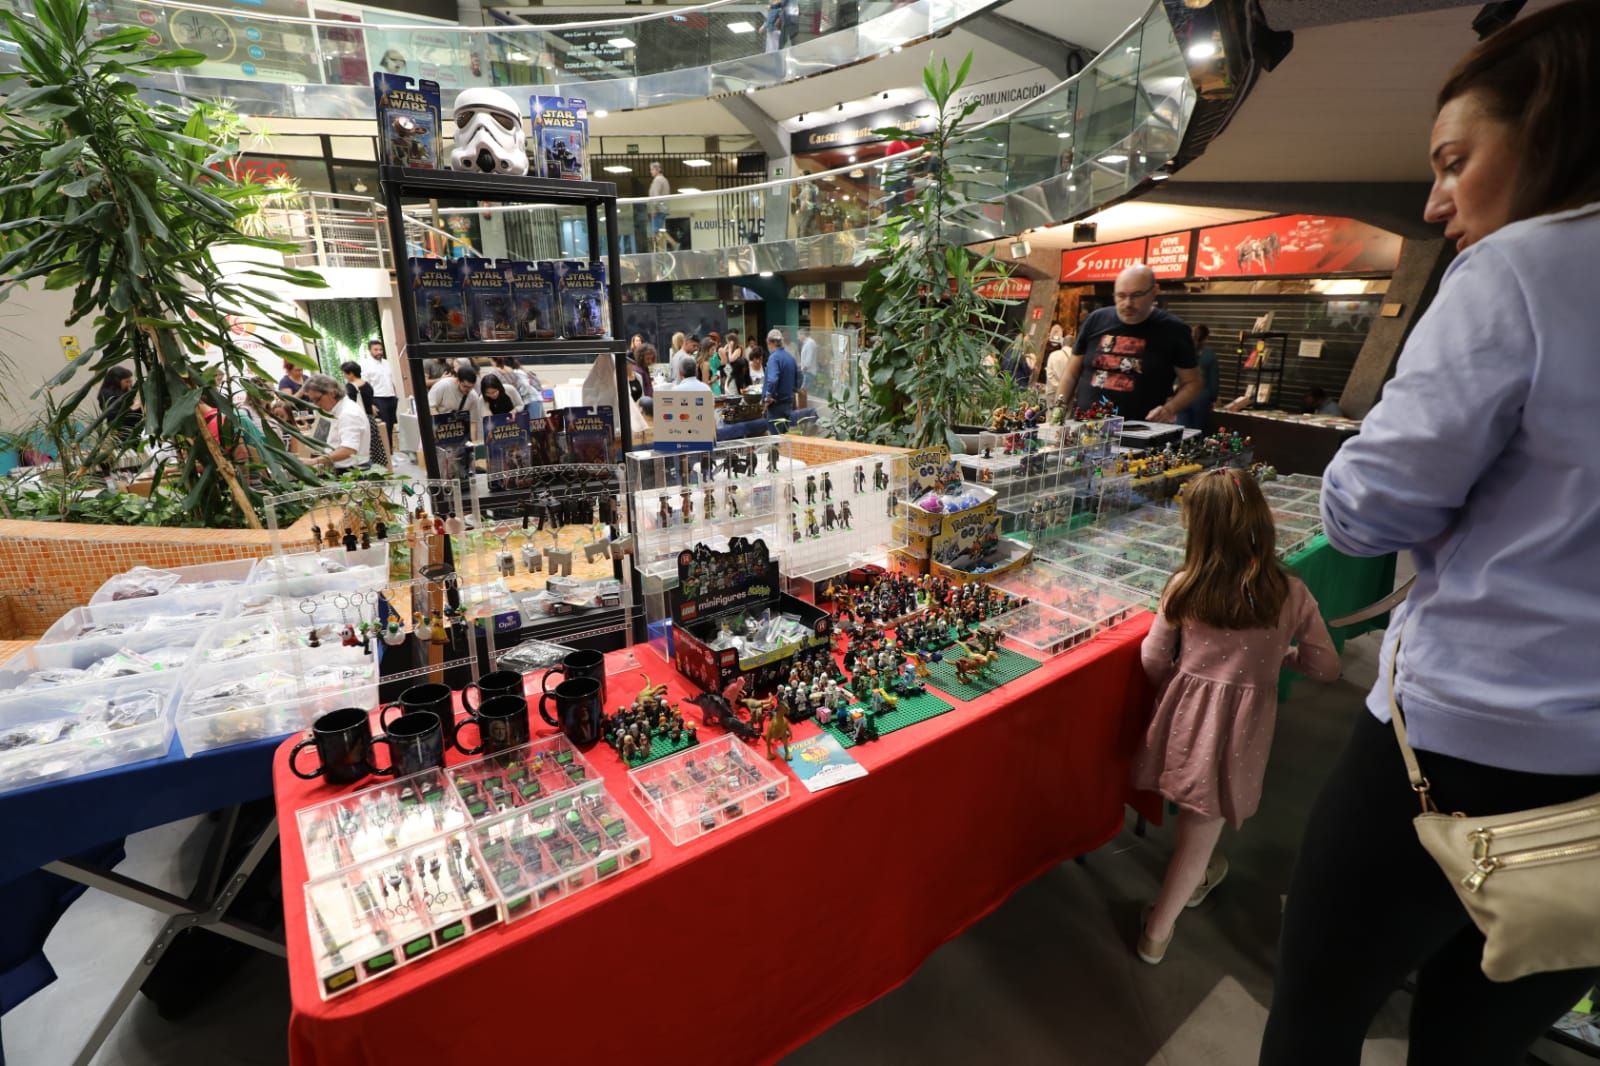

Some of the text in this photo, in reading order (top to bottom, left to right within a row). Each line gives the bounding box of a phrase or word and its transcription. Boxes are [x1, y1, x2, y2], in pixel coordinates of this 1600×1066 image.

[389, 90, 427, 103] STAR
[390, 99, 427, 112] WARS
[543, 110, 575, 119] STAR
[543, 118, 576, 127] WARS
[421, 271, 453, 280] STAR
[471, 271, 502, 280] STAR
[514, 273, 544, 281] STAR
[565, 272, 595, 281] STAR
[422, 279, 453, 288] WARS
[472, 279, 503, 288] WARS
[567, 280, 595, 288] WARS
[575, 417, 604, 425] STAR
[438, 422, 465, 432] STAR
[494, 423, 521, 433] STAR
[576, 423, 604, 431] WARS
[438, 430, 465, 440] WARS
[494, 430, 521, 440] WARS
[920, 465, 935, 477] GO
[961, 526, 975, 539] GO
[698, 591, 747, 611] minifigures
[721, 668, 732, 677] 5+
